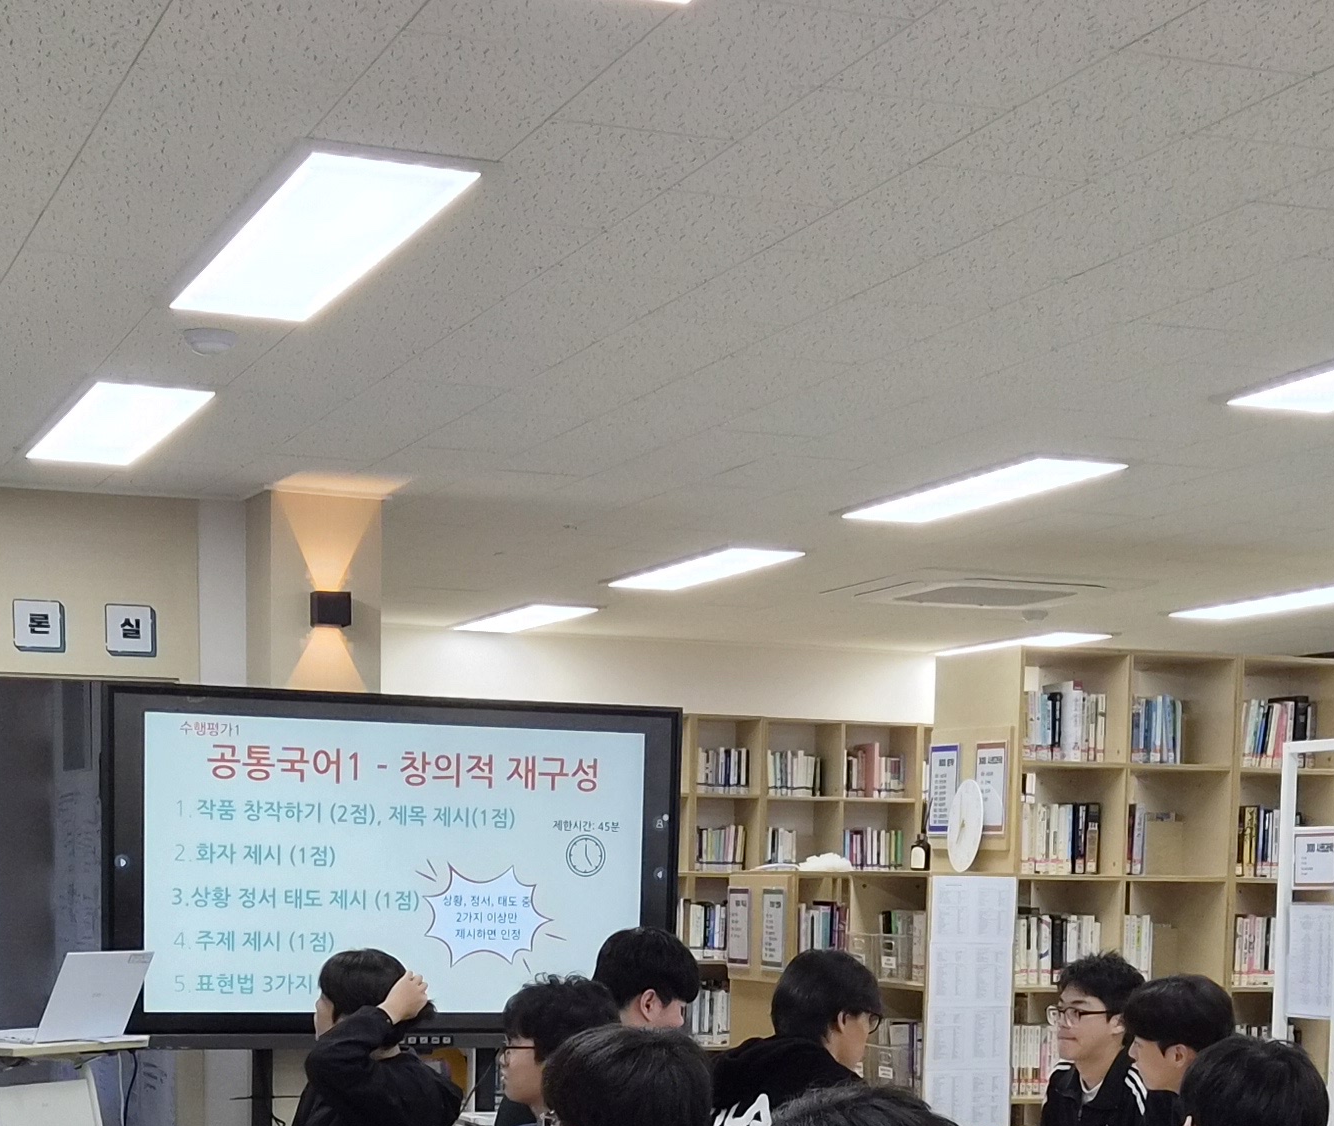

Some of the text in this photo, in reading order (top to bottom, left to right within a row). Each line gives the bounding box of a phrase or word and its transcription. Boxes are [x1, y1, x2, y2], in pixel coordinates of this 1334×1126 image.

[29, 613, 51, 635] 론
[121, 618, 141, 639] 실
[179, 721, 241, 737] 수행평가1
[207, 744, 359, 784] 공통국어1
[400, 751, 494, 789] 창의적
[507, 755, 599, 792] 재구성
[197, 799, 236, 821] 작품
[244, 801, 321, 823] 창작하기
[330, 803, 381, 826] (2점),
[389, 805, 427, 827] 제목
[433, 806, 515, 830] 제시(1점)
[553, 819, 620, 832] 제한시간: 45분
[196, 843, 236, 865] 화자
[243, 844, 282, 866] 제시
[290, 845, 336, 867] (1점)
[239, 888, 277, 909] 정서
[284, 889, 323, 909] 태도
[330, 890, 367, 911] 제시
[375, 890, 419, 912] (1점)
[456, 912, 518, 924] 2가지 이상만
[195, 931, 235, 951] 주제
[242, 931, 281, 951] 제시
[289, 931, 335, 953] (1점)
[455, 929, 521, 941] 제시하면 인정
[195, 974, 254, 994] 표현법
[263, 974, 313, 994] 3가지
